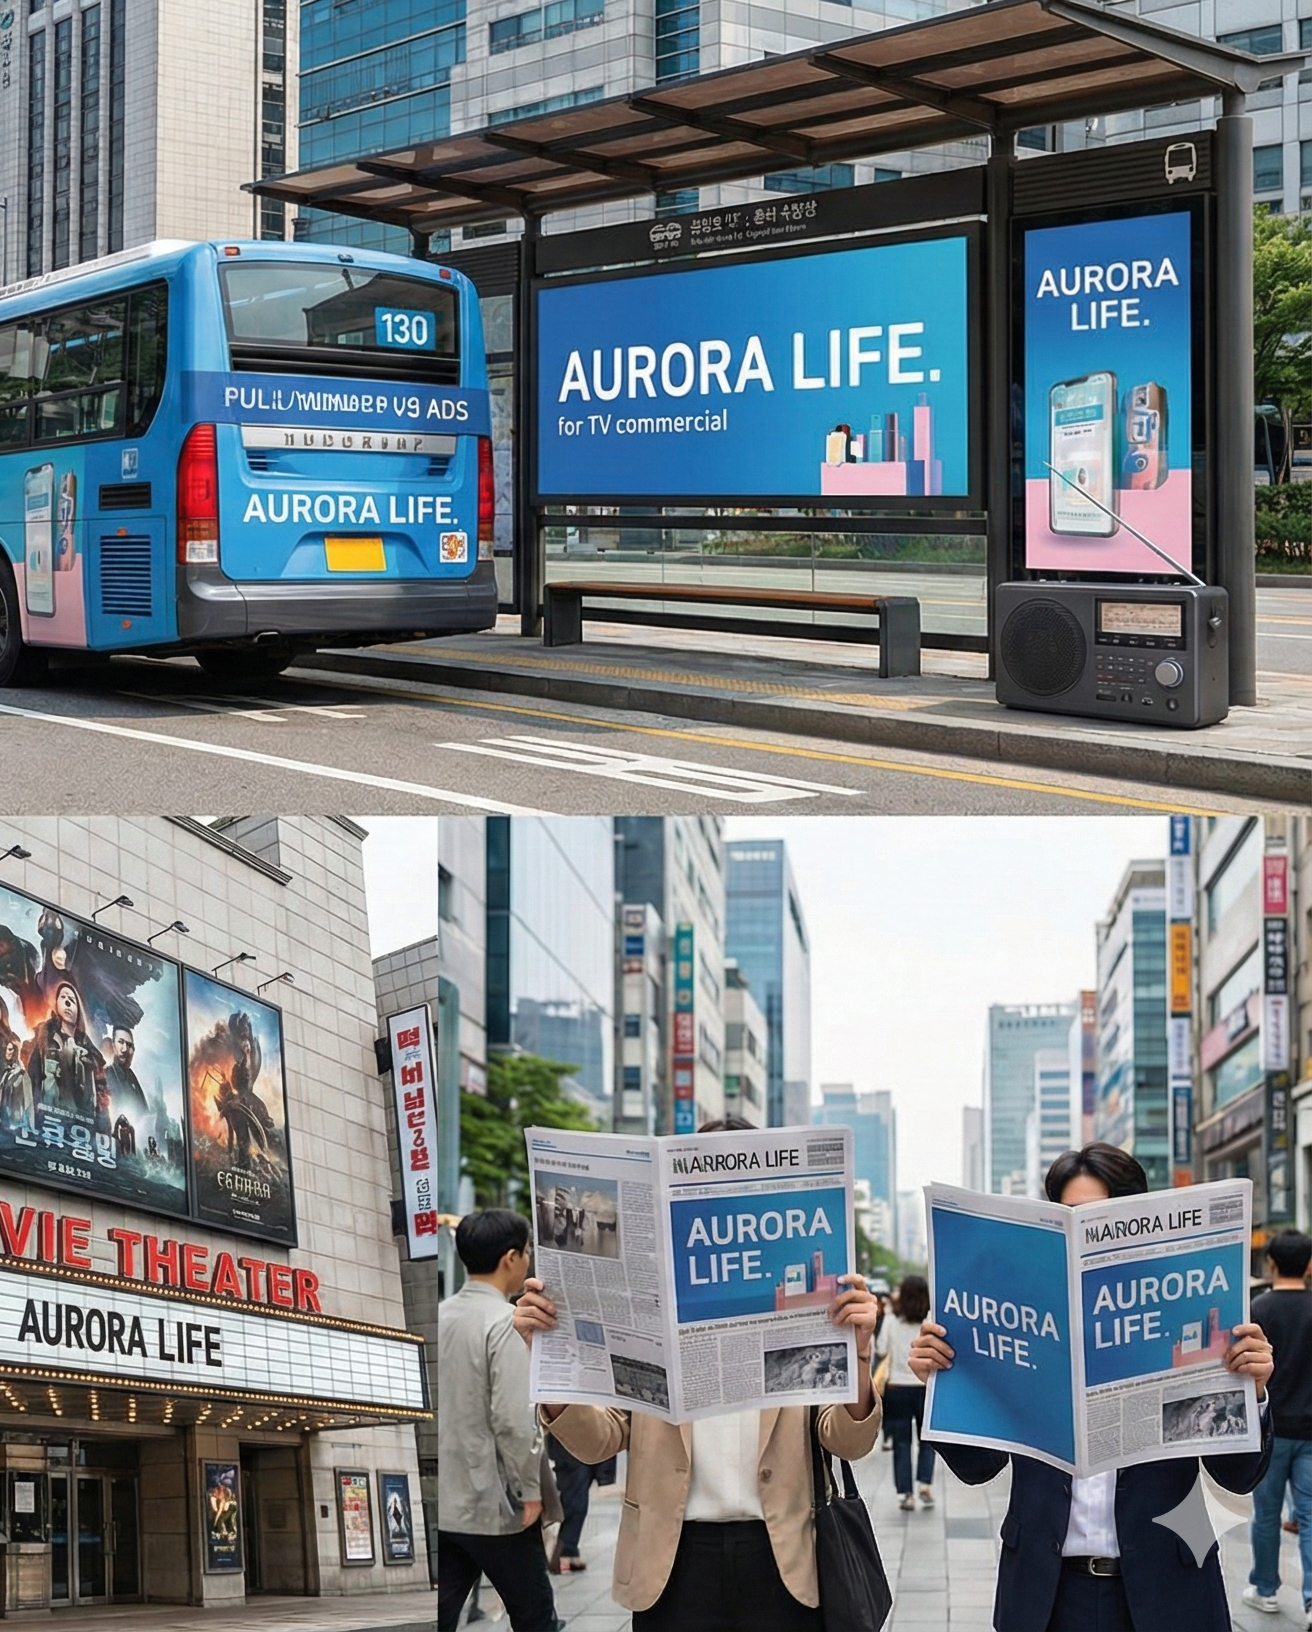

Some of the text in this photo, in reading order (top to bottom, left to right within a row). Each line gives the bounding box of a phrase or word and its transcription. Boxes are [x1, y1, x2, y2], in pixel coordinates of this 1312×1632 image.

[1036, 257, 1179, 298] AURORA
[381, 313, 428, 346] 130
[1071, 298, 1150, 330] LIFE.
[558, 322, 941, 402] AURORA LIFE.
[427, 399, 468, 421] ADS
[558, 408, 728, 436] for TV commercial
[243, 494, 458, 525] AURORA LIFE.
[766, 1149, 799, 1168] LIFE
[687, 1207, 833, 1248] AURORA
[1169, 1208, 1202, 1230] LIFE
[107, 1227, 323, 1314] THEATER
[688, 1249, 772, 1286] LIFE.
[1092, 1265, 1229, 1315] AURORA
[18, 1299, 223, 1368] AURORA LIFE
[944, 1288, 1060, 1342] AURORA
[1094, 1310, 1170, 1350] LIFE.
[972, 1327, 1037, 1370] LIFE.
